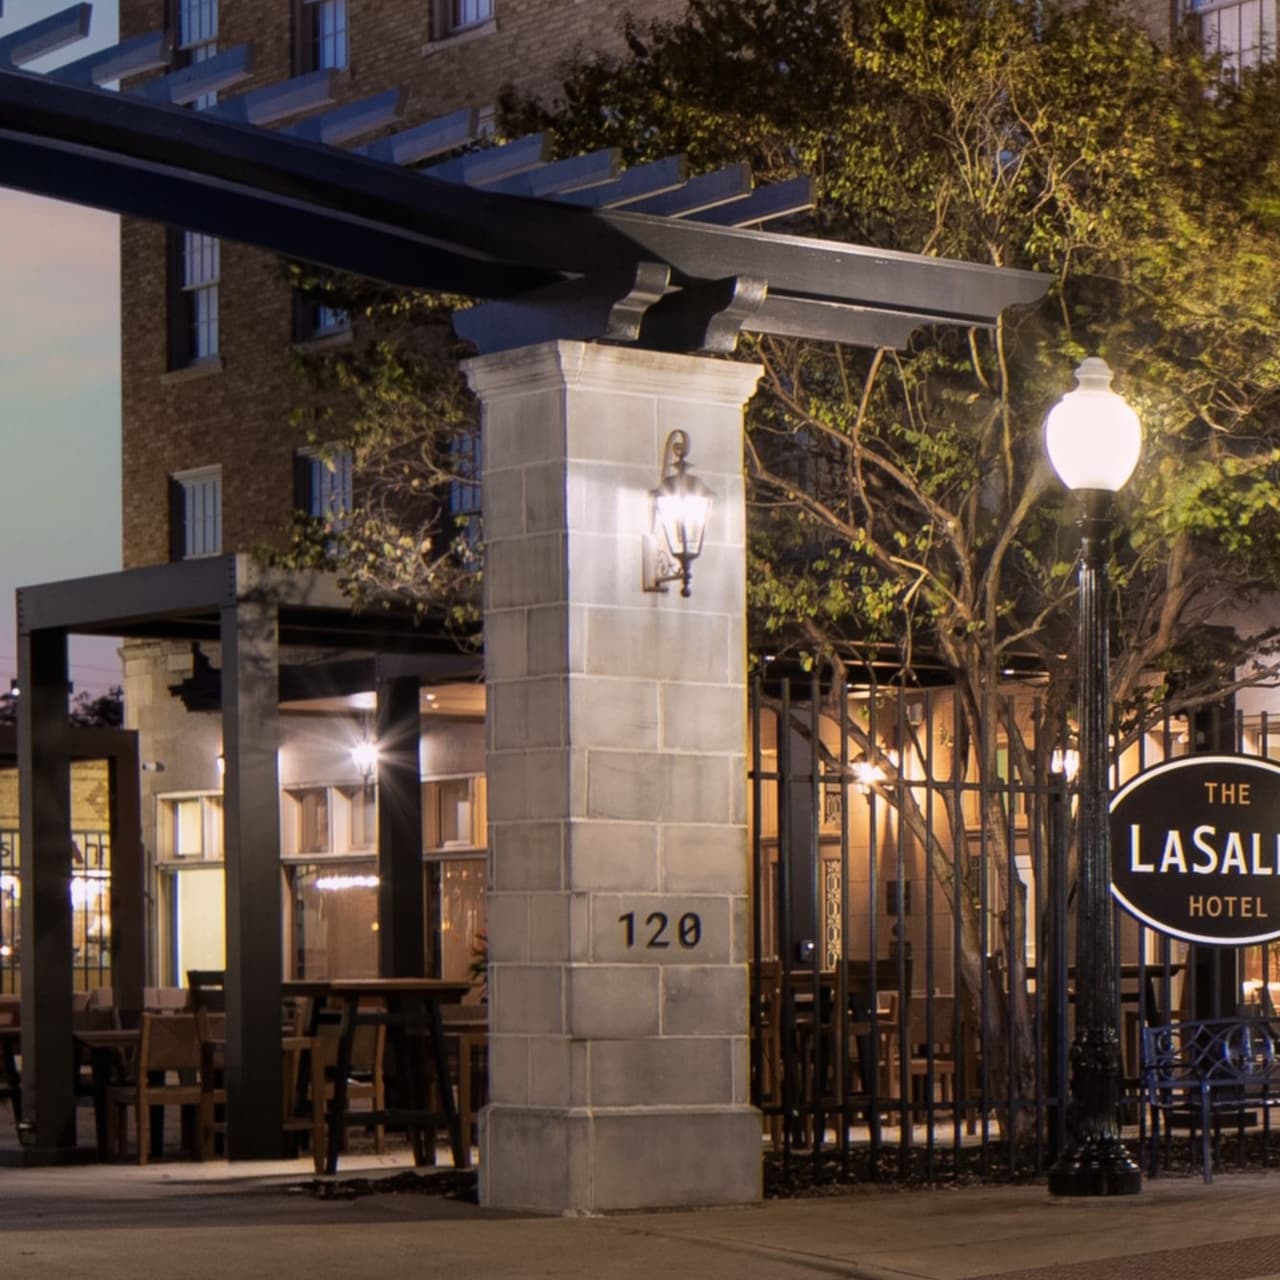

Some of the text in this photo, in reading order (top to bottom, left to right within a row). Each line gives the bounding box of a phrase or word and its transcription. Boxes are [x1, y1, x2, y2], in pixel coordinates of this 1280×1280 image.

[1204, 781, 1252, 805] THE
[1189, 895, 1269, 918] HOTEL
[618, 911, 702, 949] 120
